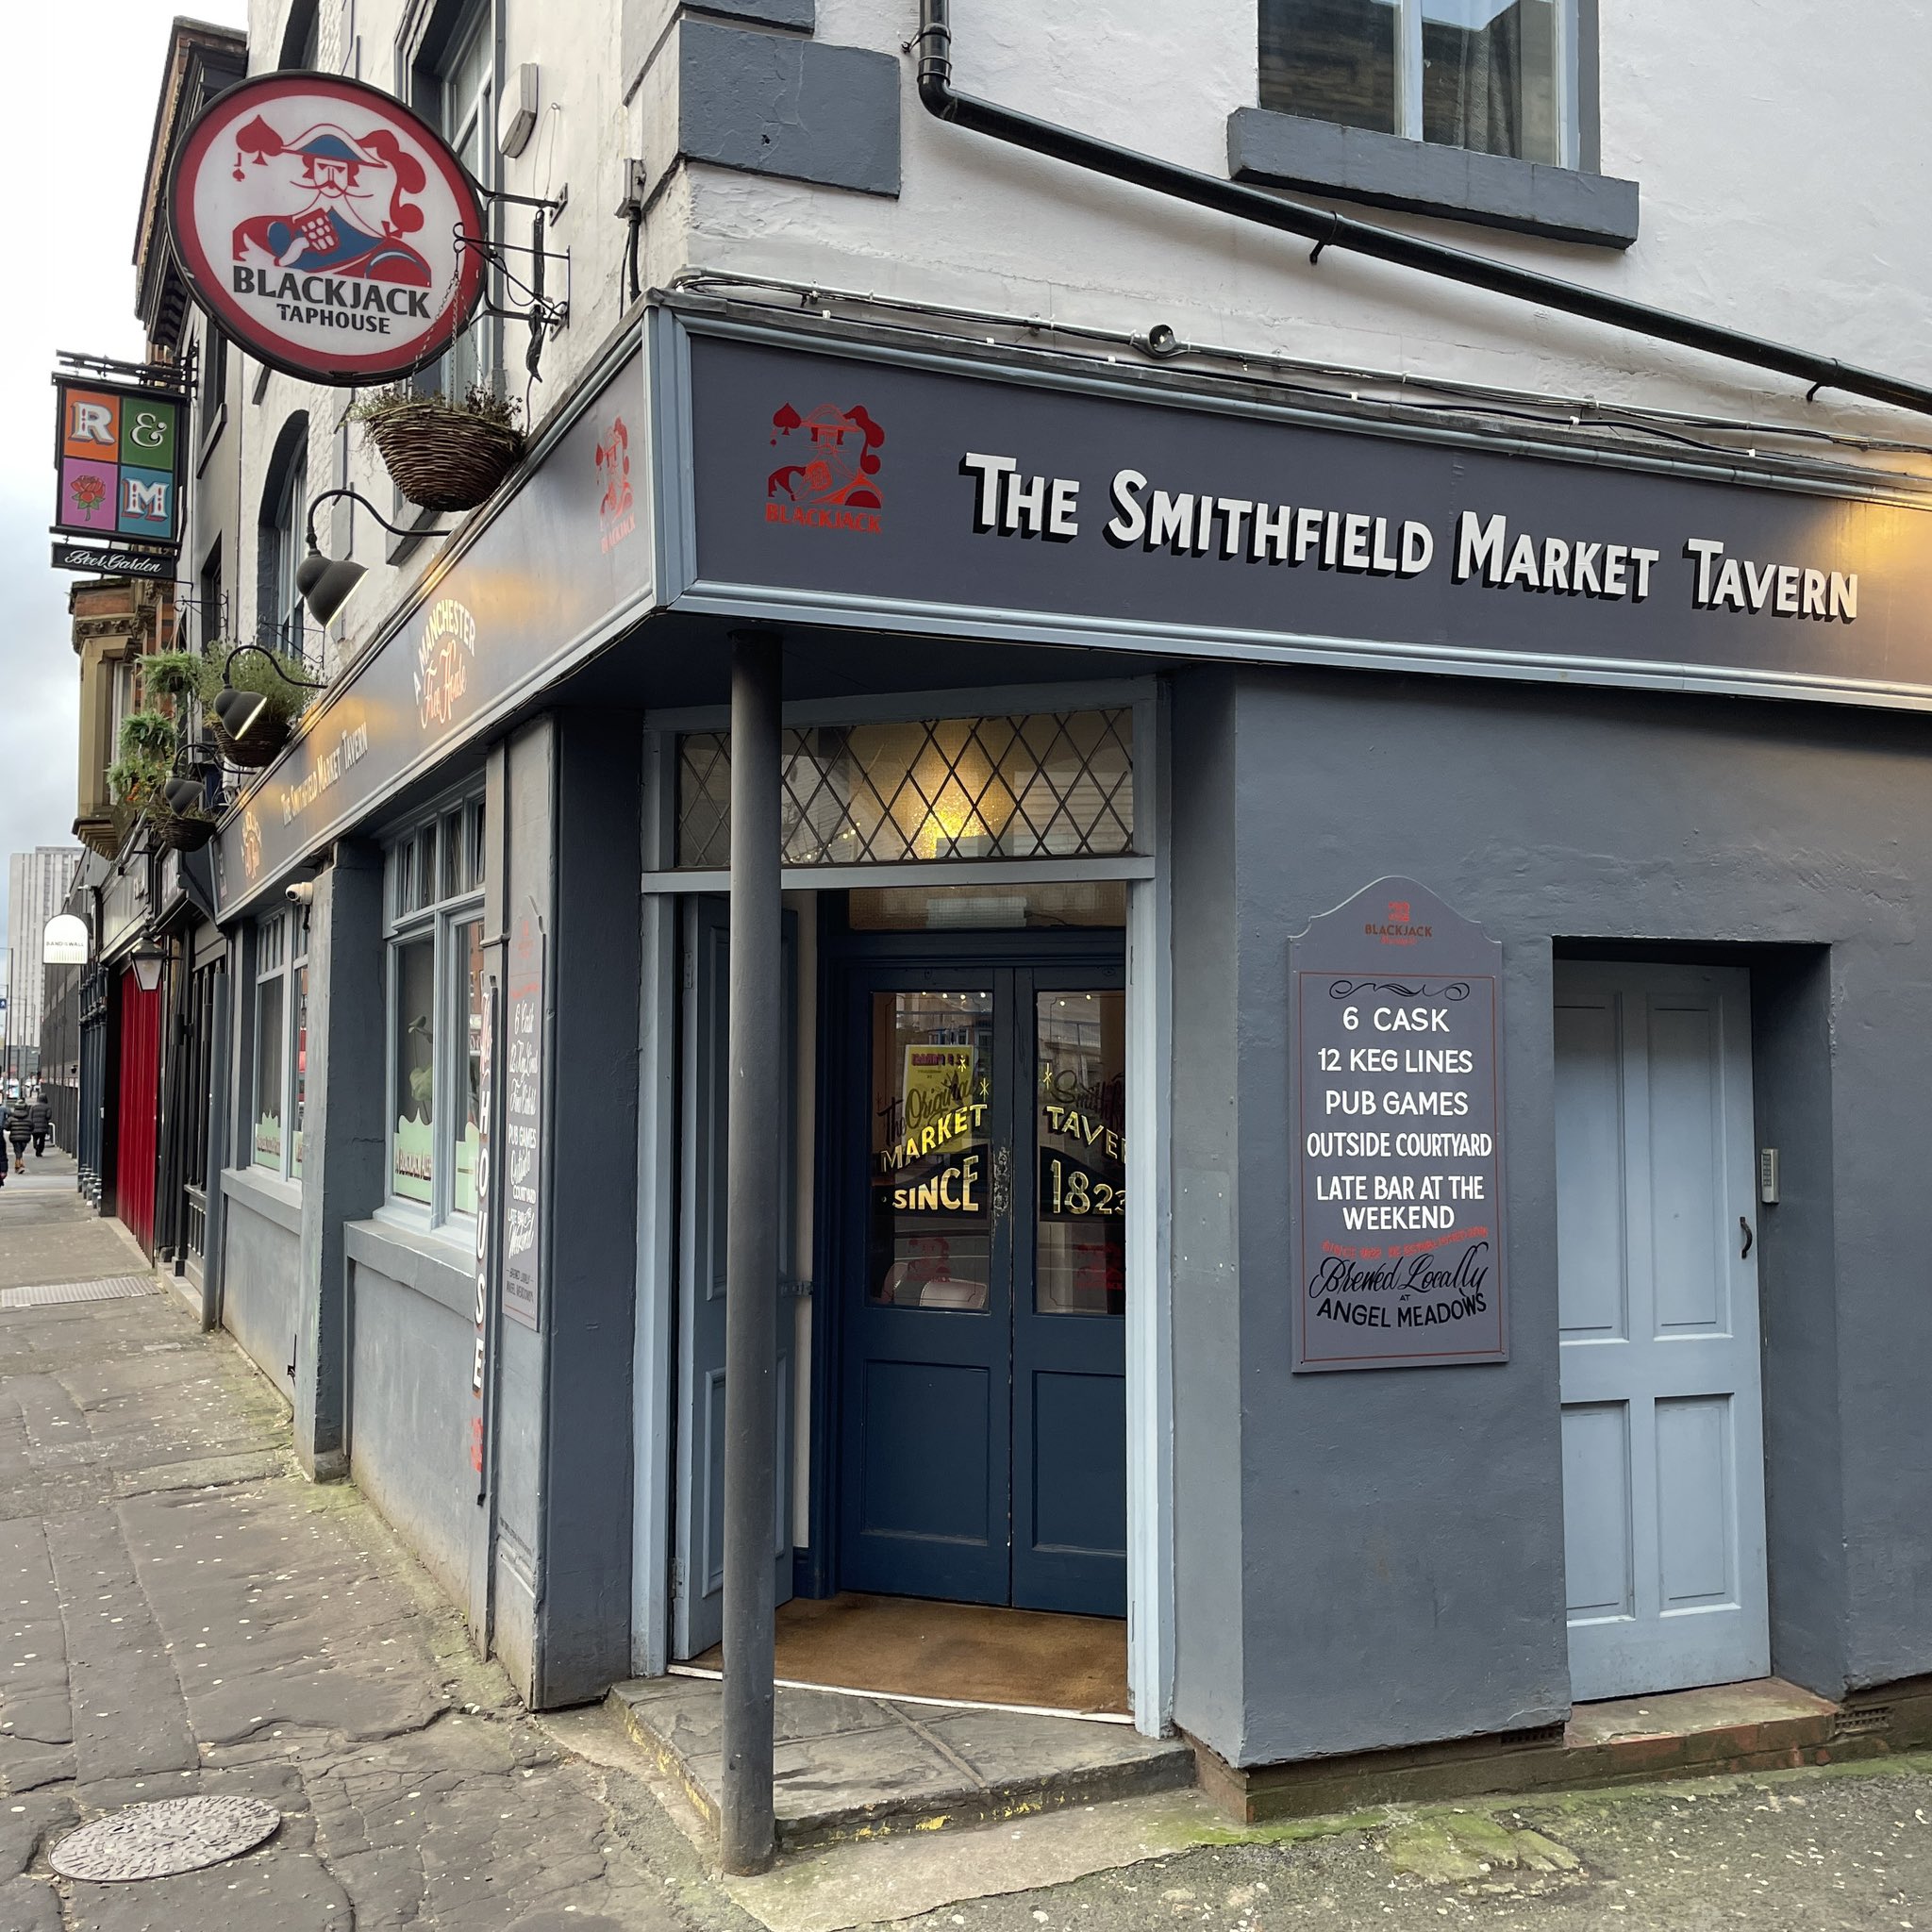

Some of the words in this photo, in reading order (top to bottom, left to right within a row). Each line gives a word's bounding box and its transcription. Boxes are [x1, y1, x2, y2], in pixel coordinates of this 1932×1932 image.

[233, 265, 431, 319] BLACKJACK
[276, 303, 391, 334] TAPHOUSE
[70, 401, 116, 444] R
[130, 412, 167, 447] &
[122, 477, 170, 522] M
[765, 503, 883, 534] BLACKJACK
[963, 452, 1080, 539] THE
[1105, 469, 1434, 576] SMITHFIELD
[1455, 510, 1659, 600] MARKET
[1685, 538, 1857, 621] TAVERN
[65, 549, 106, 568] Beer
[104, 553, 161, 574] Garden
[419, 599, 476, 676] MANCHESTER
[1365, 923, 1433, 938] BLACKJACK
[1342, 1007, 1358, 1030] 6
[1374, 1008, 1450, 1032] CASK
[1318, 1049, 1341, 1071] 12
[1350, 1049, 1398, 1071] KEG
[1406, 1050, 1473, 1074] LINES
[1325, 1091, 1376, 1115] PUB
[1383, 1091, 1469, 1116] GAMES
[877, 1097, 907, 1146] The
[880, 1105, 988, 1173] MARKET
[1045, 1106, 1126, 1165] TAVE
[1307, 1133, 1391, 1157] OUTSIDE
[1396, 1133, 1492, 1157] COURTYARD
[893, 1156, 979, 1212] SINCE
[1317, 1176, 1368, 1200] LATE
[1374, 1176, 1415, 1200] BAR
[1420, 1176, 1443, 1199] AT
[1448, 1176, 1484, 1200] THE
[1342, 1206, 1455, 1230] WEEKEND
[1309, 1257, 1404, 1298] Brewed
[1398, 1241, 1489, 1296] Locally
[1317, 1298, 1391, 1327] ANGEL
[1398, 1293, 1487, 1327] MEADOWS
[1399, 1293, 1411, 1302] AT
